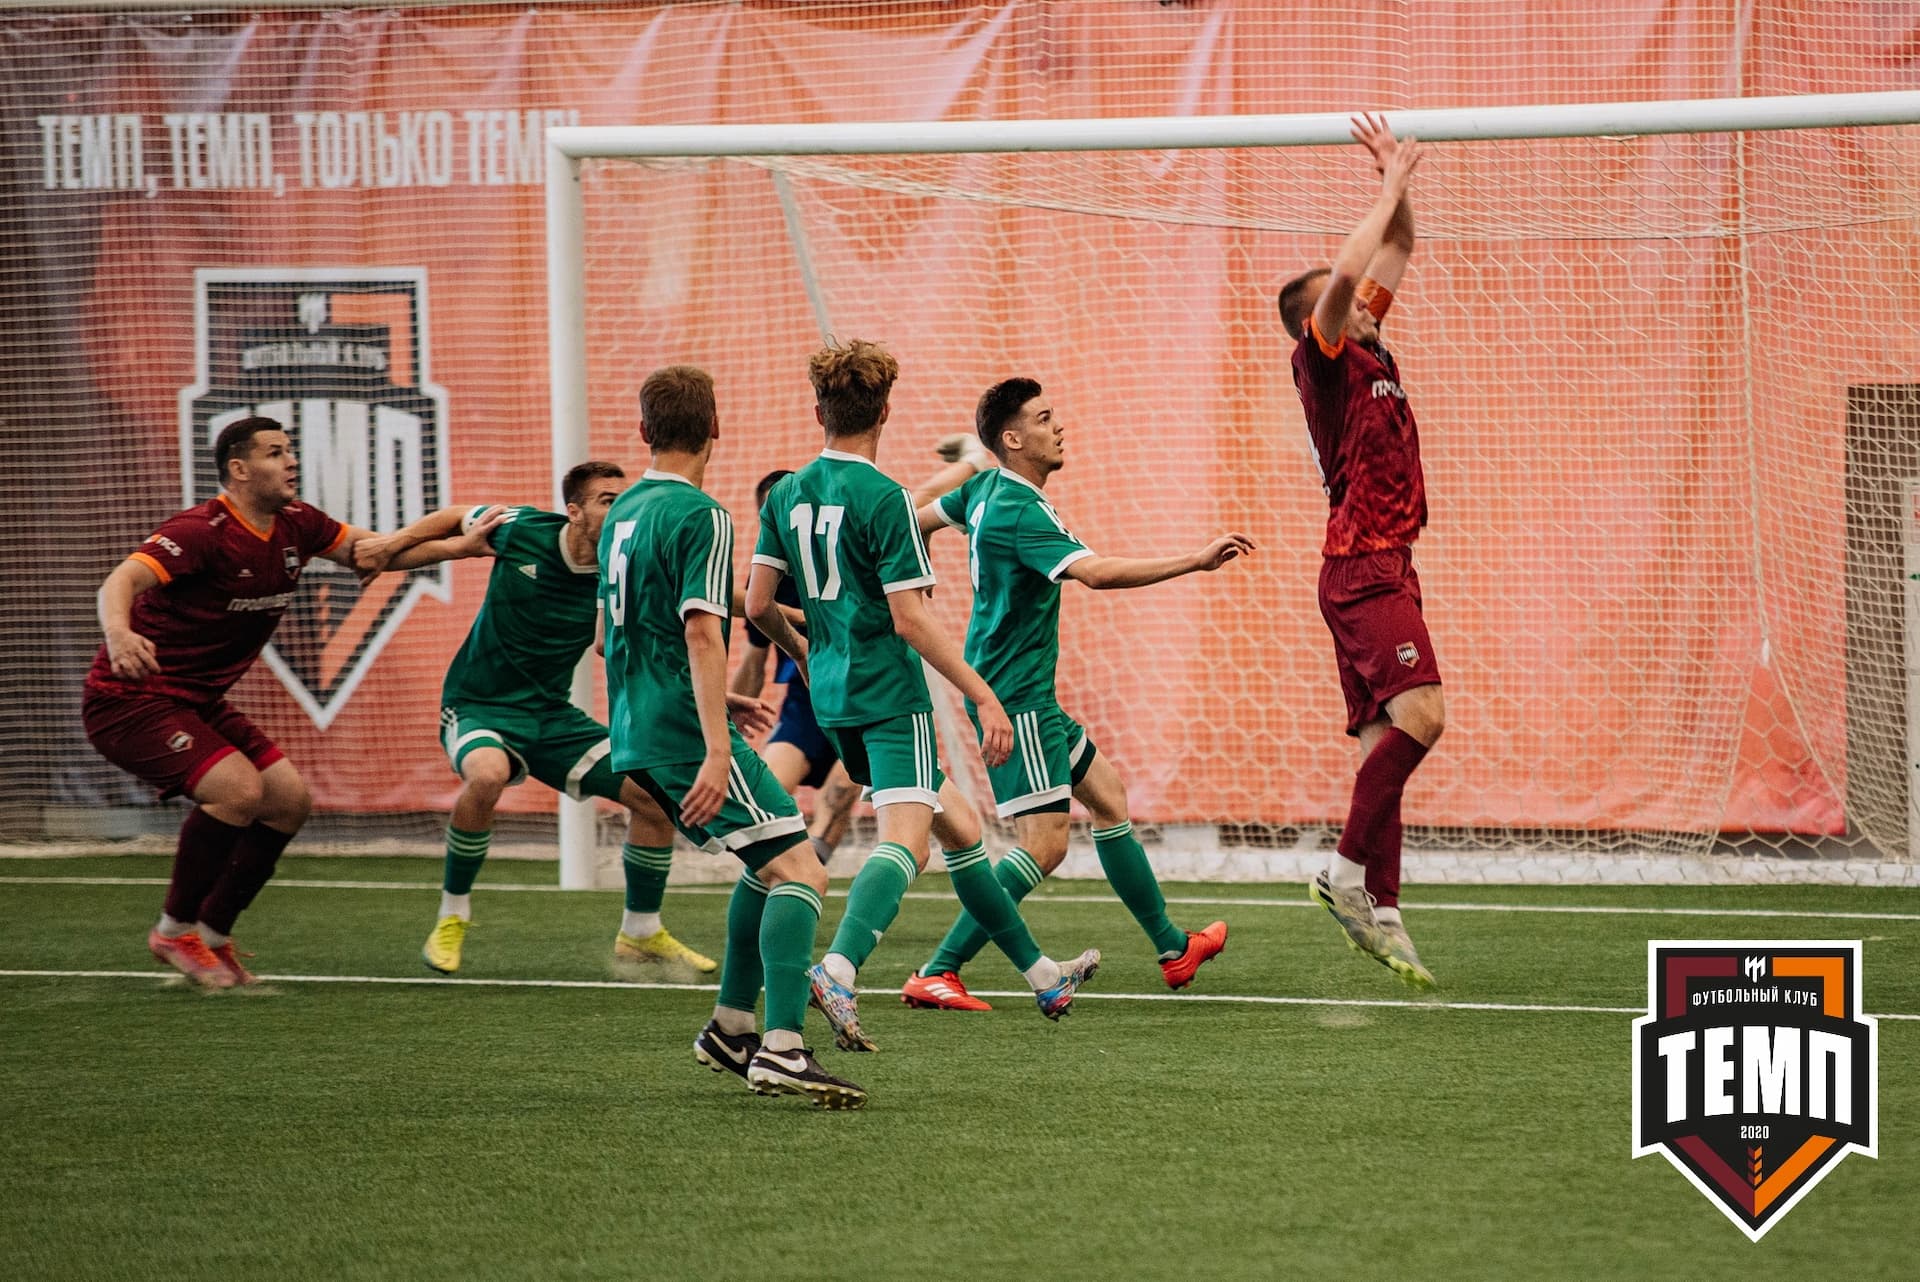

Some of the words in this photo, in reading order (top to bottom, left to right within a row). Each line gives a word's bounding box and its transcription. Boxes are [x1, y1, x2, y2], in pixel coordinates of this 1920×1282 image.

[38, 113, 158, 198] ТЕМП,
[164, 113, 287, 197] ТЕМП,
[295, 111, 453, 188] ТОЛЬКО
[463, 109, 580, 185] ТЕМ
[608, 520, 636, 626] 5
[790, 503, 845, 600] 17
